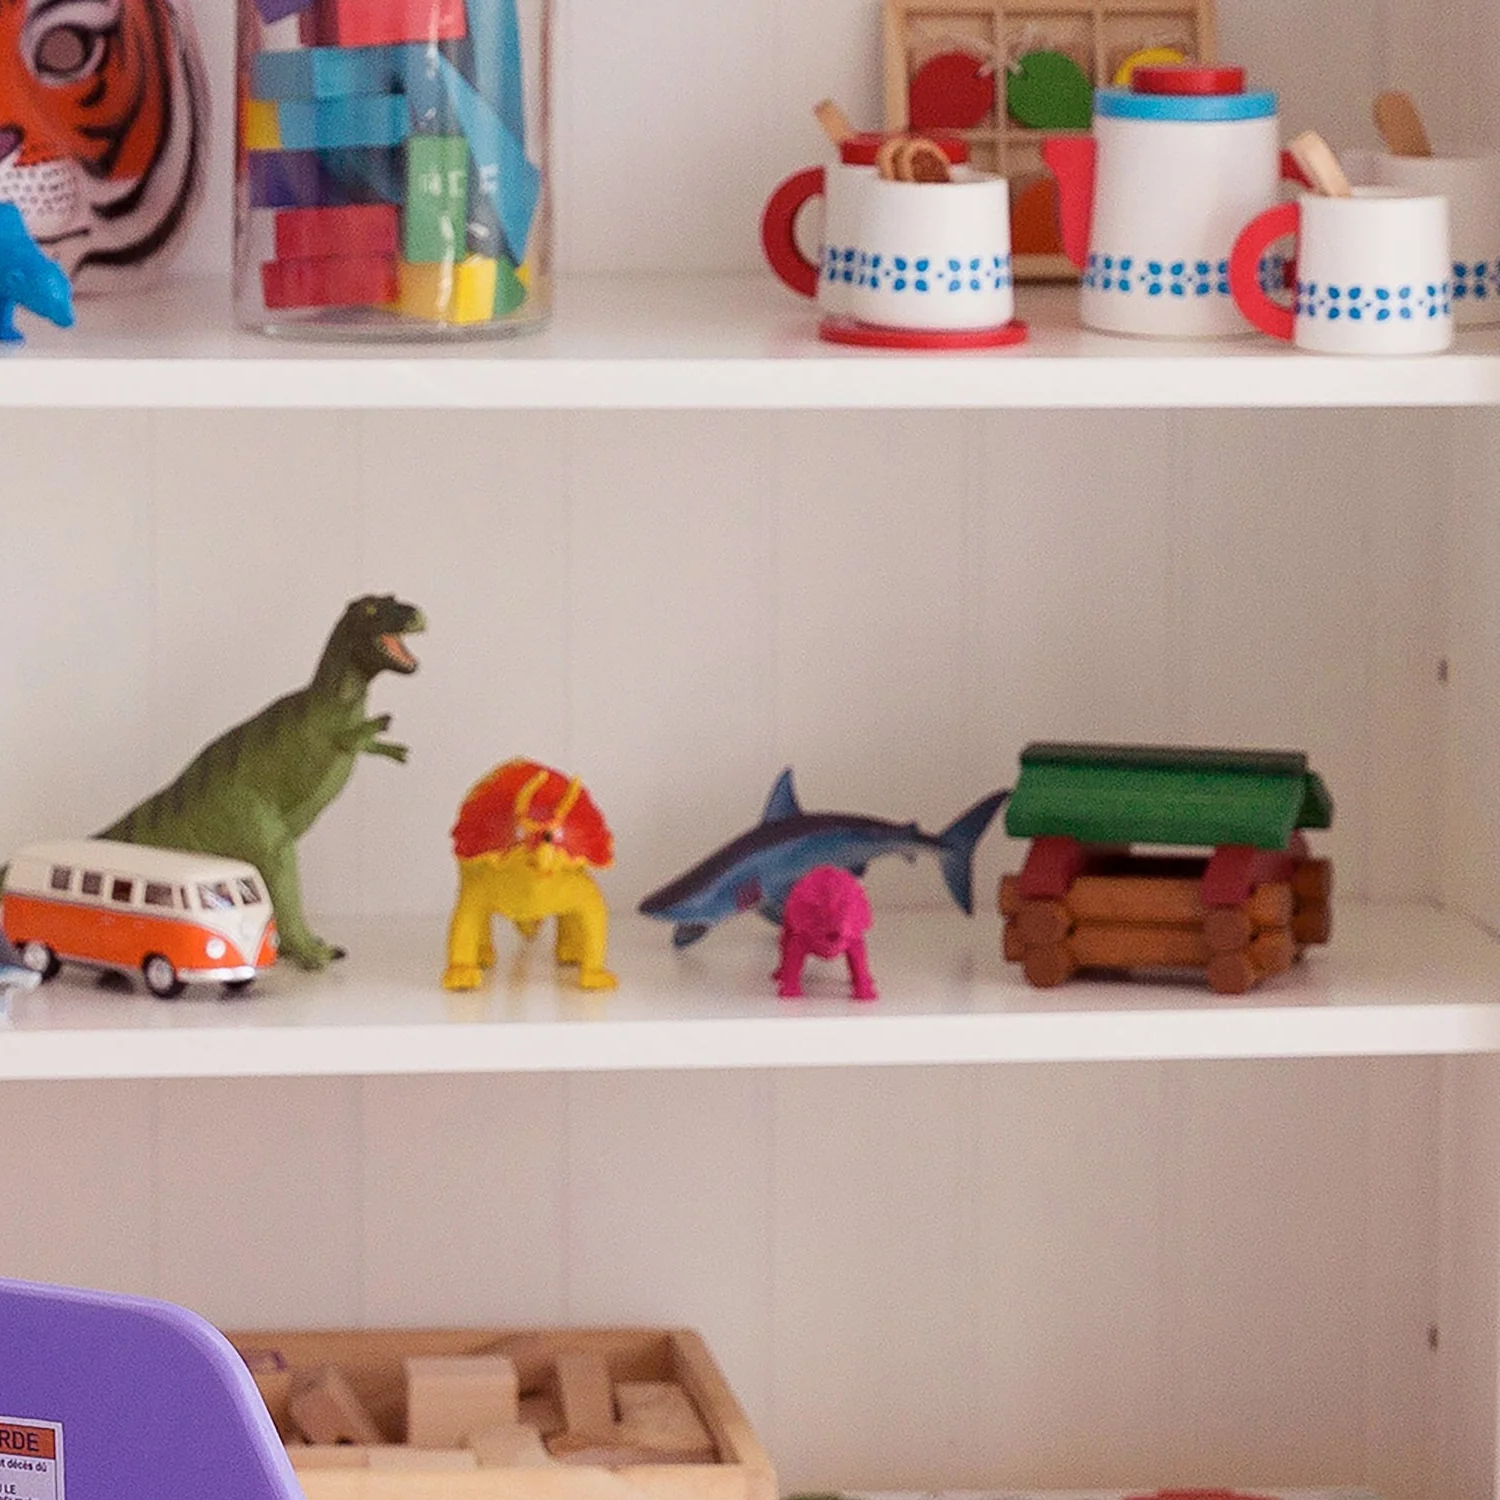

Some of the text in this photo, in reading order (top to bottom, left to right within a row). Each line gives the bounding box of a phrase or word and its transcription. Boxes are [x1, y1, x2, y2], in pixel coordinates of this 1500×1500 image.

[7, 1459, 33, 1470] décès
[35, 1462, 47, 1472] dû
[4, 1484, 16, 1495] LE
